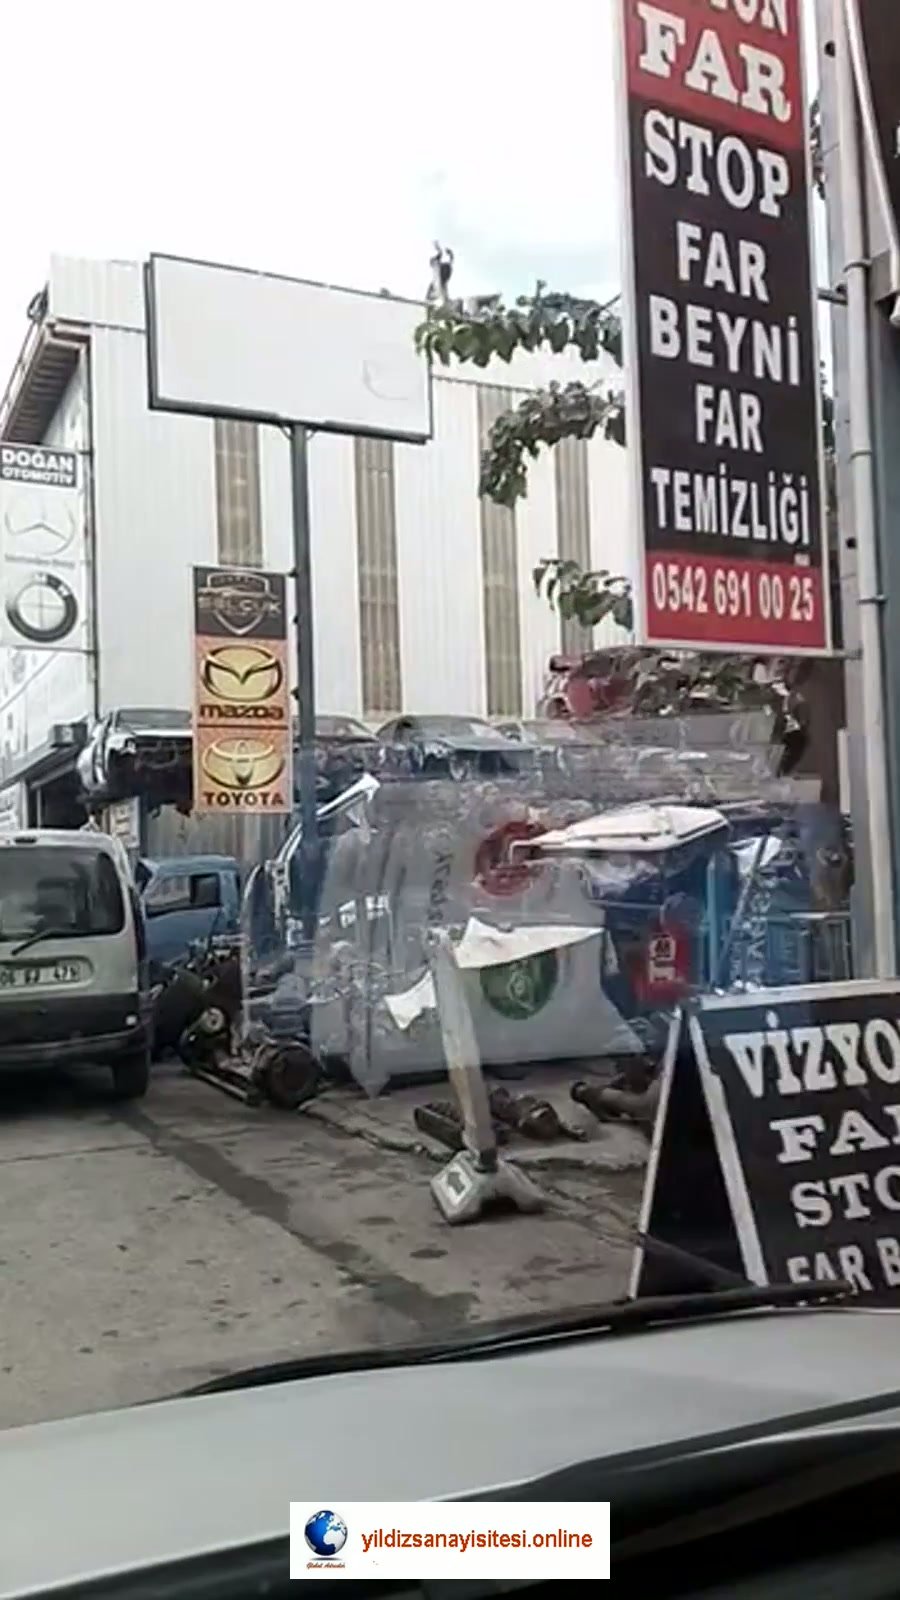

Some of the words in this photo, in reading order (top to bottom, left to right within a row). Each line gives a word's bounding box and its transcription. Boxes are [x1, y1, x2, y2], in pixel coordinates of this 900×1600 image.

[637, 2, 791, 122] FAR
[643, 109, 789, 217] STOP
[677, 221, 769, 302] FAR
[650, 295, 799, 385] BEYNİ
[695, 383, 763, 453] FAR
[651, 463, 809, 545] TEMİZLİĞİ
[652, 562, 708, 613] 0542
[713, 568, 750, 617] 691
[758, 572, 783, 619] 00
[789, 576, 814, 621] 25
[204, 792, 284, 806] TOYOTA
[723, 1010, 900, 1098] VİZYO
